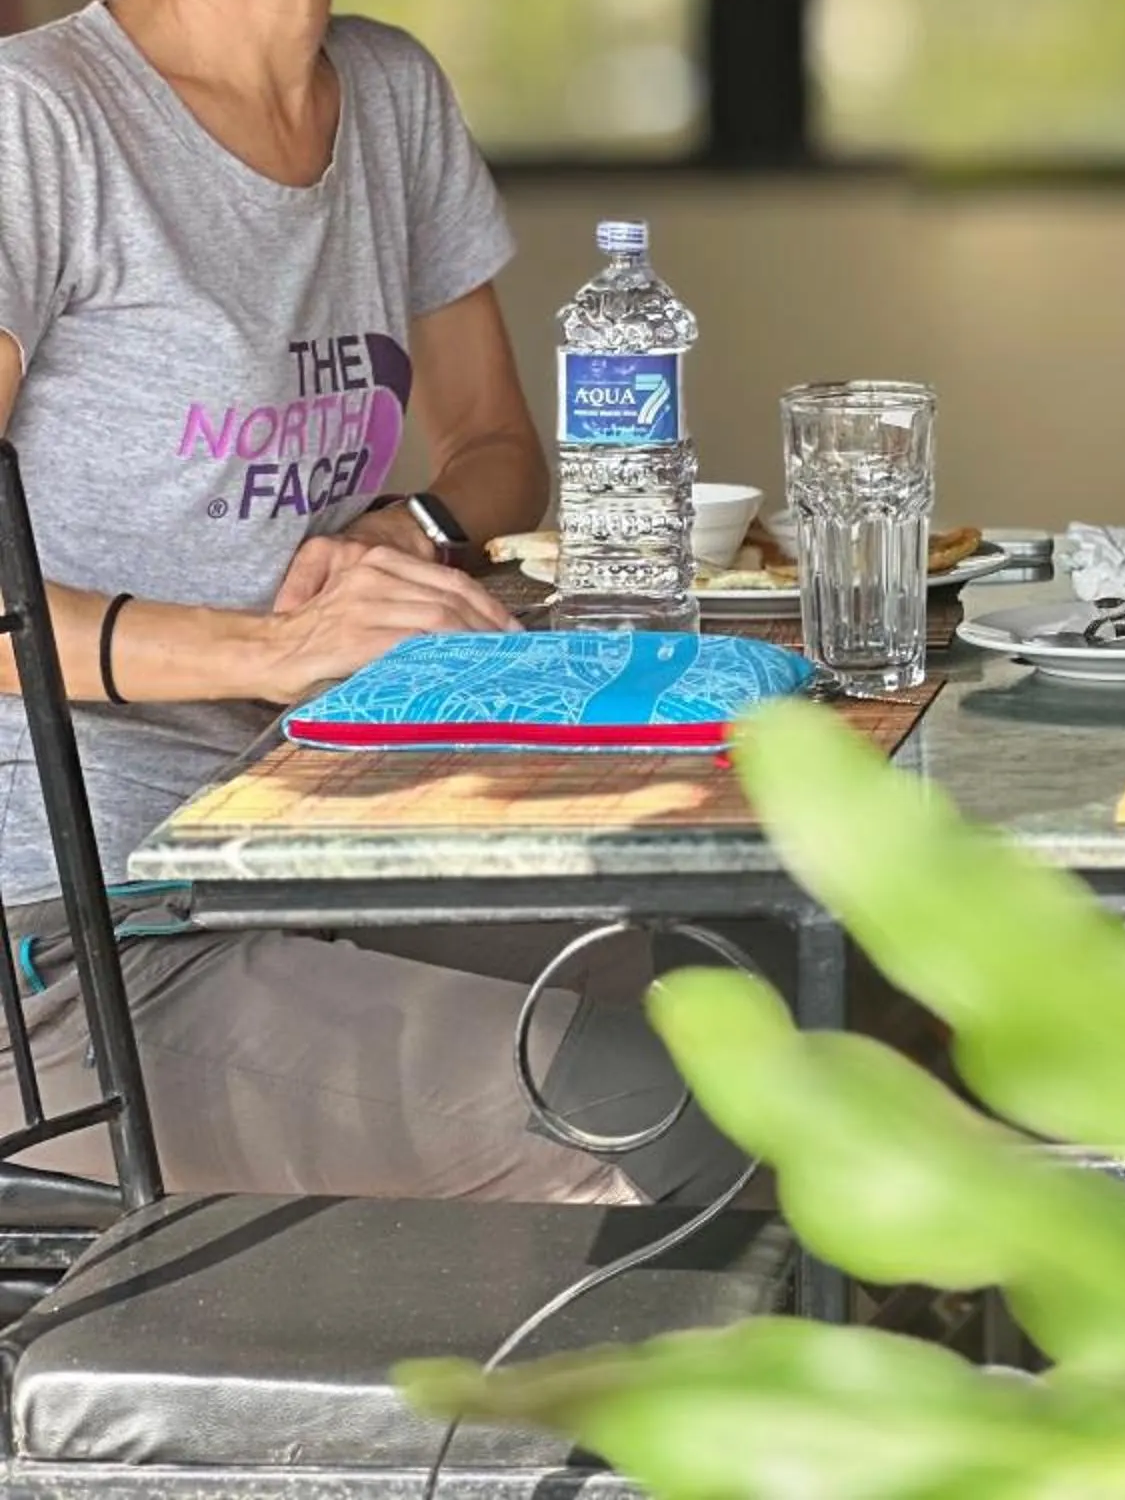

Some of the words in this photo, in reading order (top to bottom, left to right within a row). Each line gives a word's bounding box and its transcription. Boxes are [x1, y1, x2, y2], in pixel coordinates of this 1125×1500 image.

[289, 334, 368, 397] THE
[575, 387, 636, 407] AQUA
[176, 391, 368, 460] NORTH
[239, 451, 357, 520] FACE
